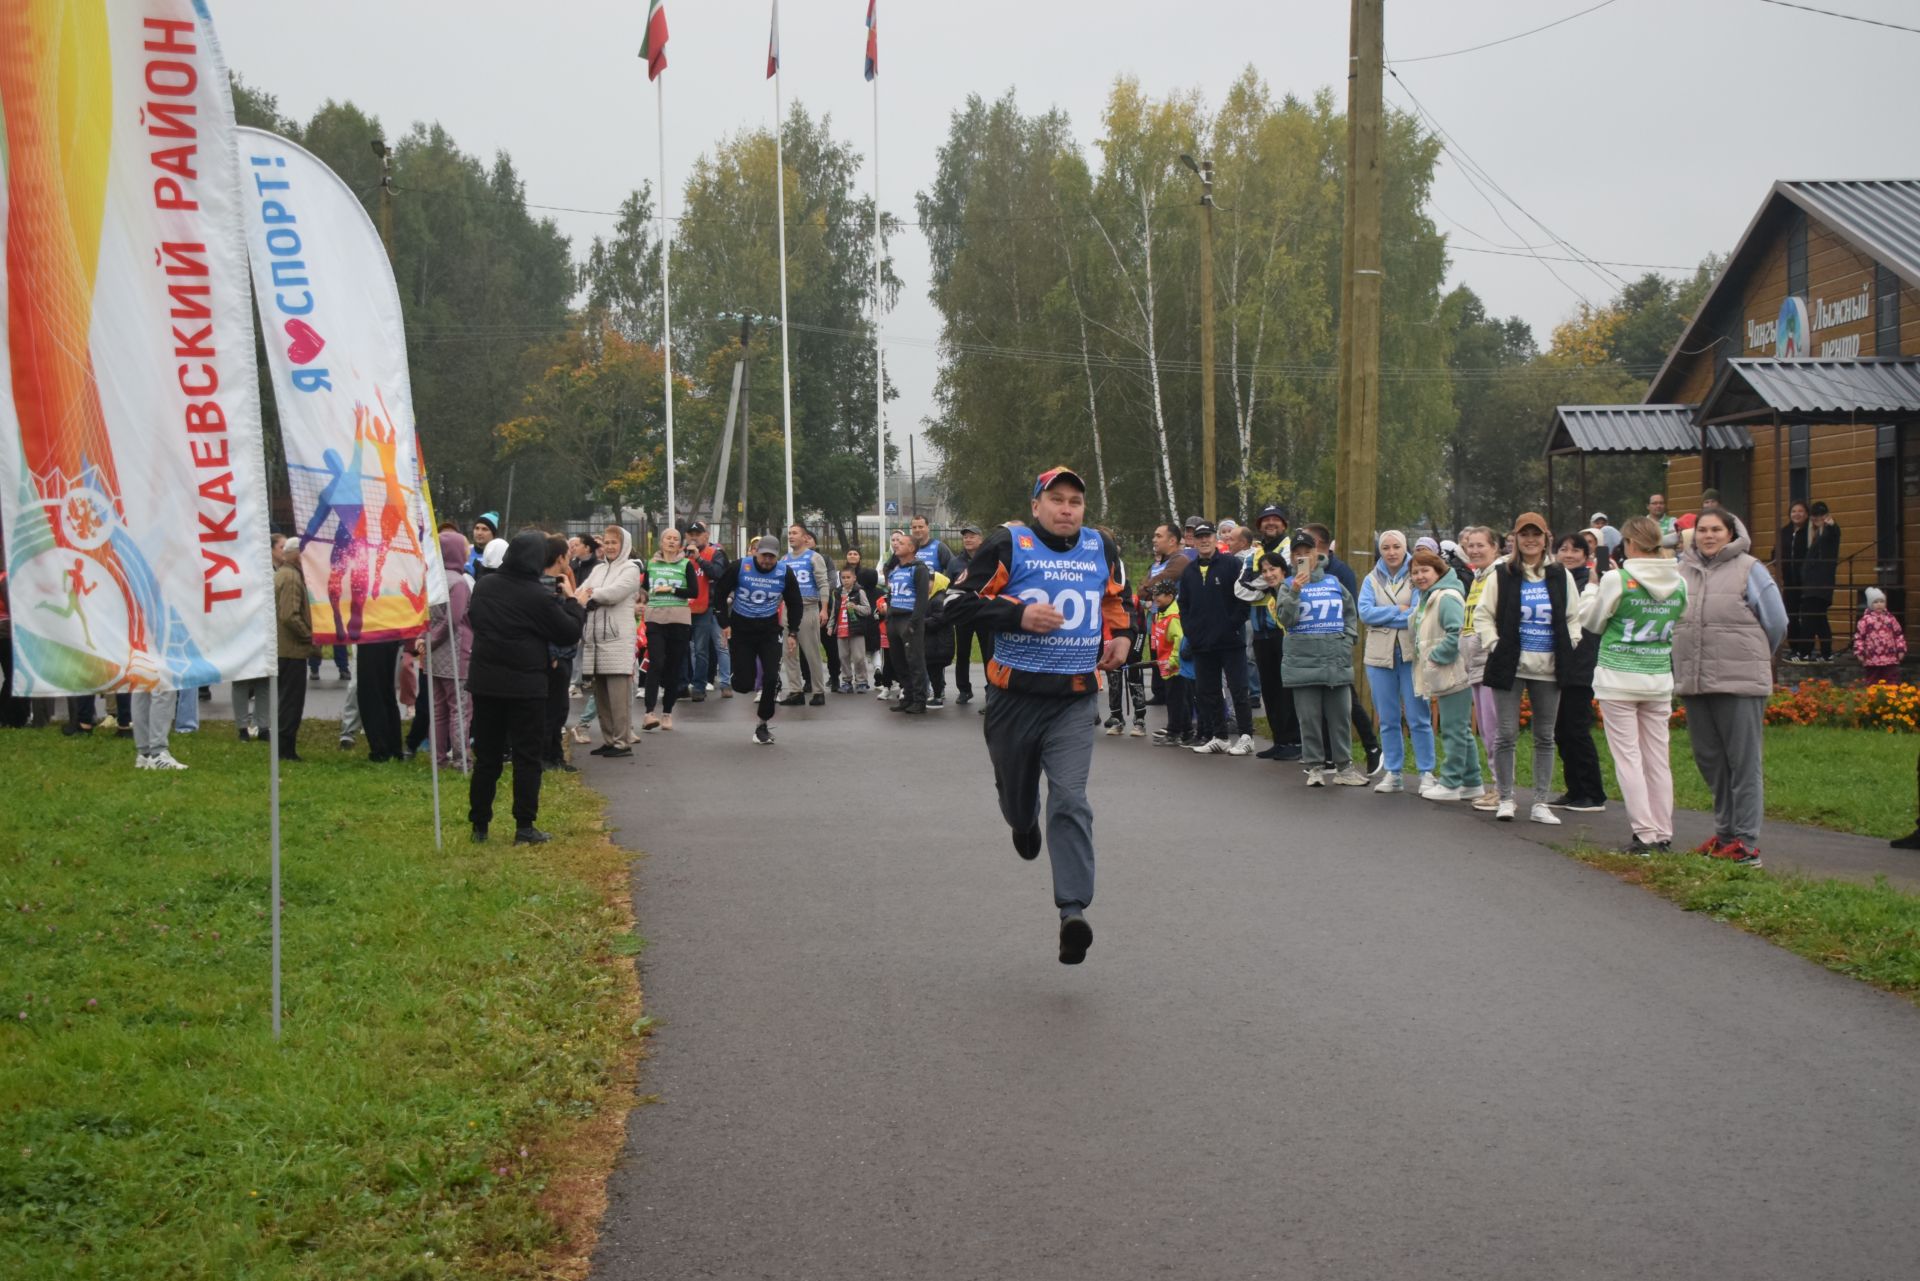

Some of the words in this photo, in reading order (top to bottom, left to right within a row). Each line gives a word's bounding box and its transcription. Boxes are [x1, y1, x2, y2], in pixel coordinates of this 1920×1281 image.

[139, 17, 200, 211] РАЙОН
[251, 156, 314, 316] СПОРТ!
[1812, 283, 1870, 331] Лыжный
[291, 368, 332, 392] Я
[154, 243, 243, 613] ТУКАЕВСКИЙ
[1025, 559, 1098, 573] ТУКАЕВСКИЙ
[1043, 570, 1084, 582] РАЙОН
[1298, 599, 1344, 621] 277
[1642, 605, 1671, 614] РАЙОН
[1040, 635, 1081, 647] НОРМА
